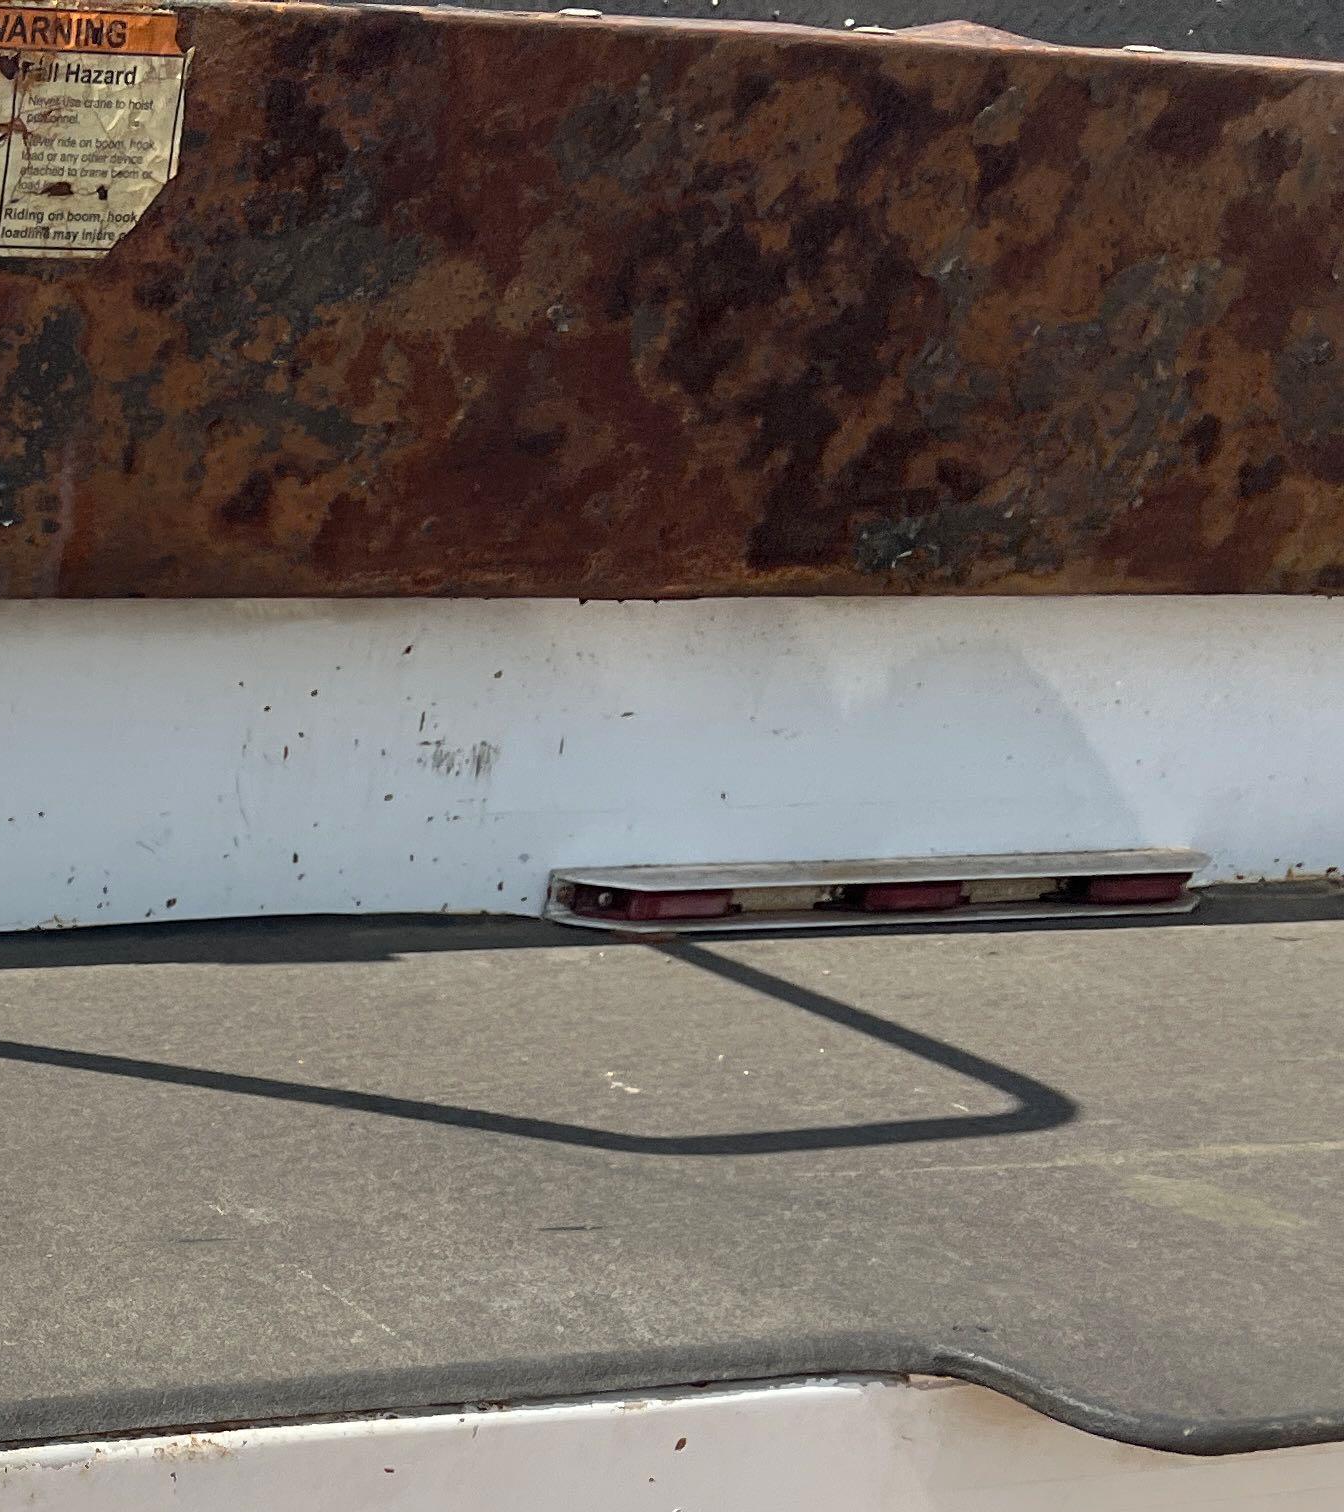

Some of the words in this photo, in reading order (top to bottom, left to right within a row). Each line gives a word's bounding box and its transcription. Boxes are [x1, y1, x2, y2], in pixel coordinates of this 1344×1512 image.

[65, 63, 138, 86] Hazard
[115, 100, 126, 109] to
[128, 99, 154, 111] hoist
[79, 138, 92, 148] on
[46, 153, 58, 162] or
[59, 152, 80, 165] any
[67, 167, 78, 177] to
[3, 208, 45, 223] Riding
[48, 211, 65, 221] on
[0, 226, 50, 240] loadline
[53, 230, 80, 243] may
[81, 228, 116, 243] injure
